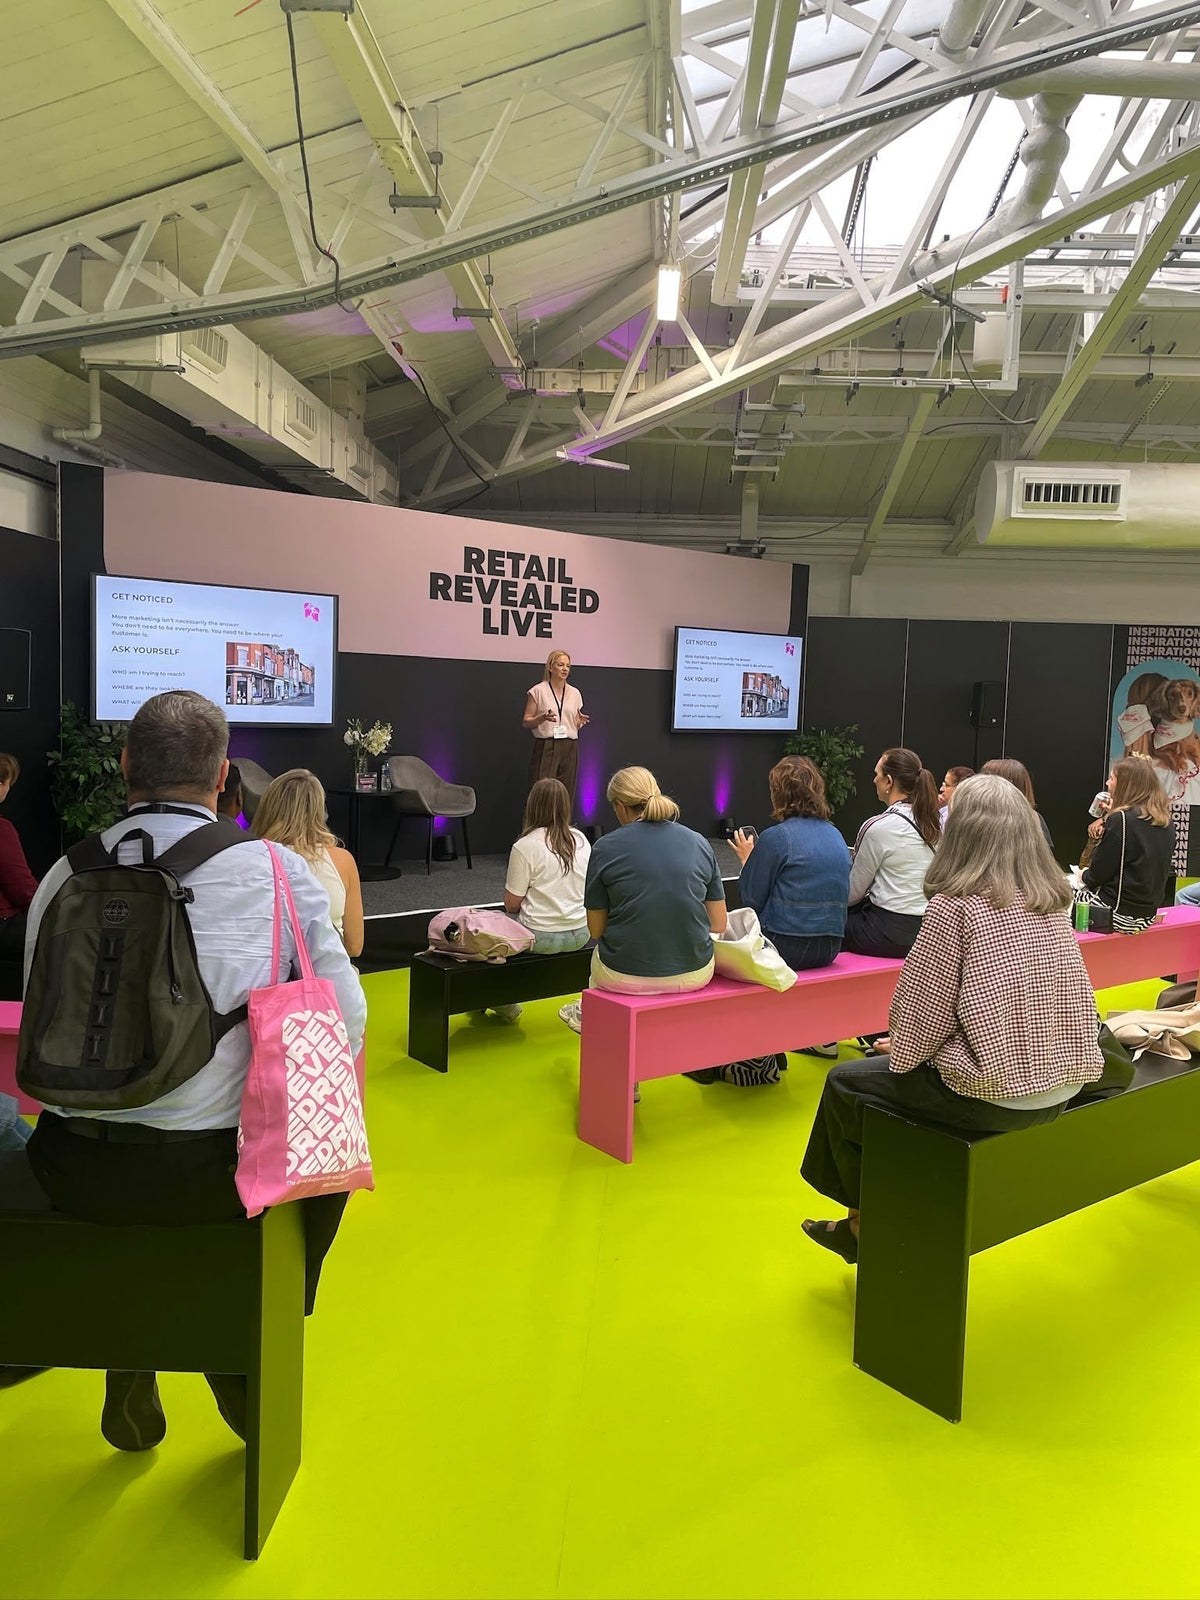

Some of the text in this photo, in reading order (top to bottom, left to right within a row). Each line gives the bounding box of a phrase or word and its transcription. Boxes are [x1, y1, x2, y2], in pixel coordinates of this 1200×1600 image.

[464, 546, 573, 585] RETAIL
[112, 592, 173, 604] GET NOTICED
[429, 571, 600, 614] REVEALED
[128, 615, 160, 623] marketing
[482, 607, 552, 638] LIVE
[1128, 627, 1200, 637] INSPIRATION
[1128, 637, 1200, 647] INSPIRATION
[112, 645, 180, 656] ASK YOURSELF
[1127, 646, 1200, 656] INSPIRATION
